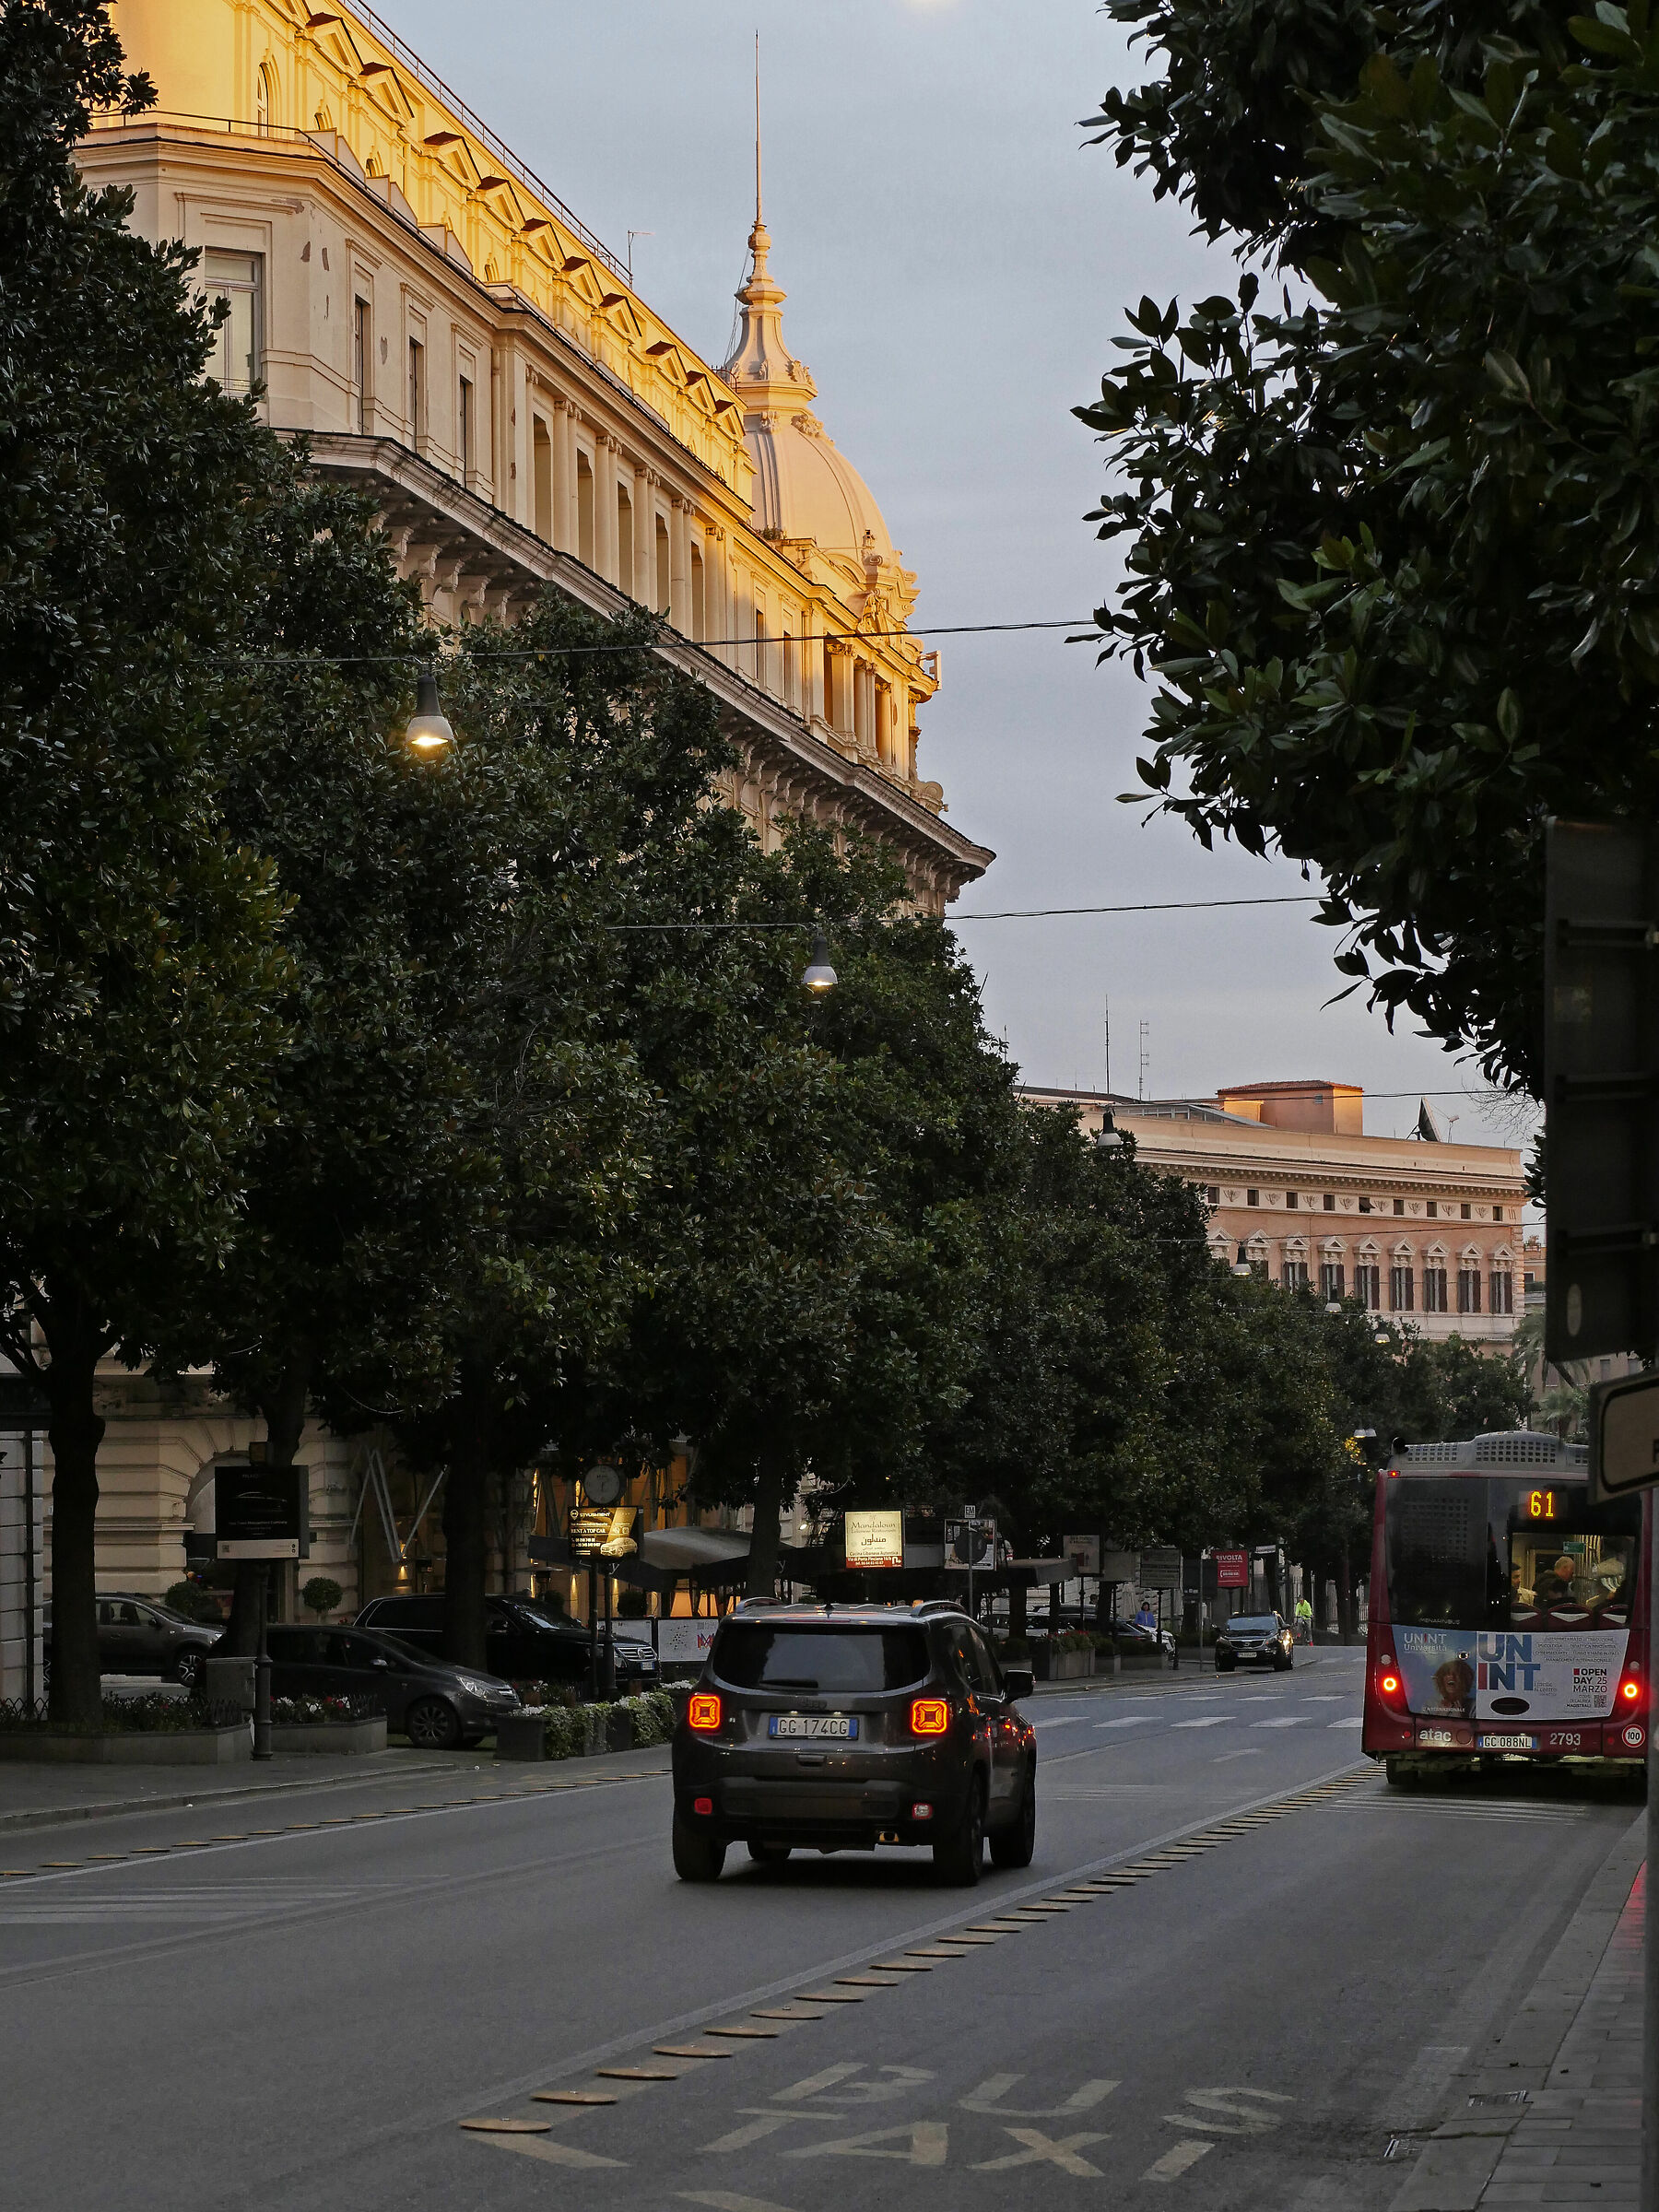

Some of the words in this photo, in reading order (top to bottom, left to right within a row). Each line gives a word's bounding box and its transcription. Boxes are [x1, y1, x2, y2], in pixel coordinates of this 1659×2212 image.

[1530, 1490, 1554, 1517] 61
[1404, 1632, 1447, 1644] UNINT
[1477, 1634, 1532, 1663] UN
[1477, 1663, 1541, 1691] INT
[1581, 1668, 1607, 1677] OPEN
[1573, 1677, 1594, 1685] DAY
[1596, 1677, 1607, 1685] 25
[1573, 1685, 1607, 1693] MARZO
[779, 1719, 796, 1734] GG
[803, 1719, 847, 1735] 174CG
[1419, 1728, 1452, 1742] atac
[1484, 1736, 1498, 1747] GC
[1500, 1736, 1531, 1747] 088NL
[1549, 1733, 1581, 1746] 2793
[1626, 1731, 1641, 1741] 100
[771, 2061, 1296, 2135] BUS
[695, 2106, 1217, 2183] TAXI
